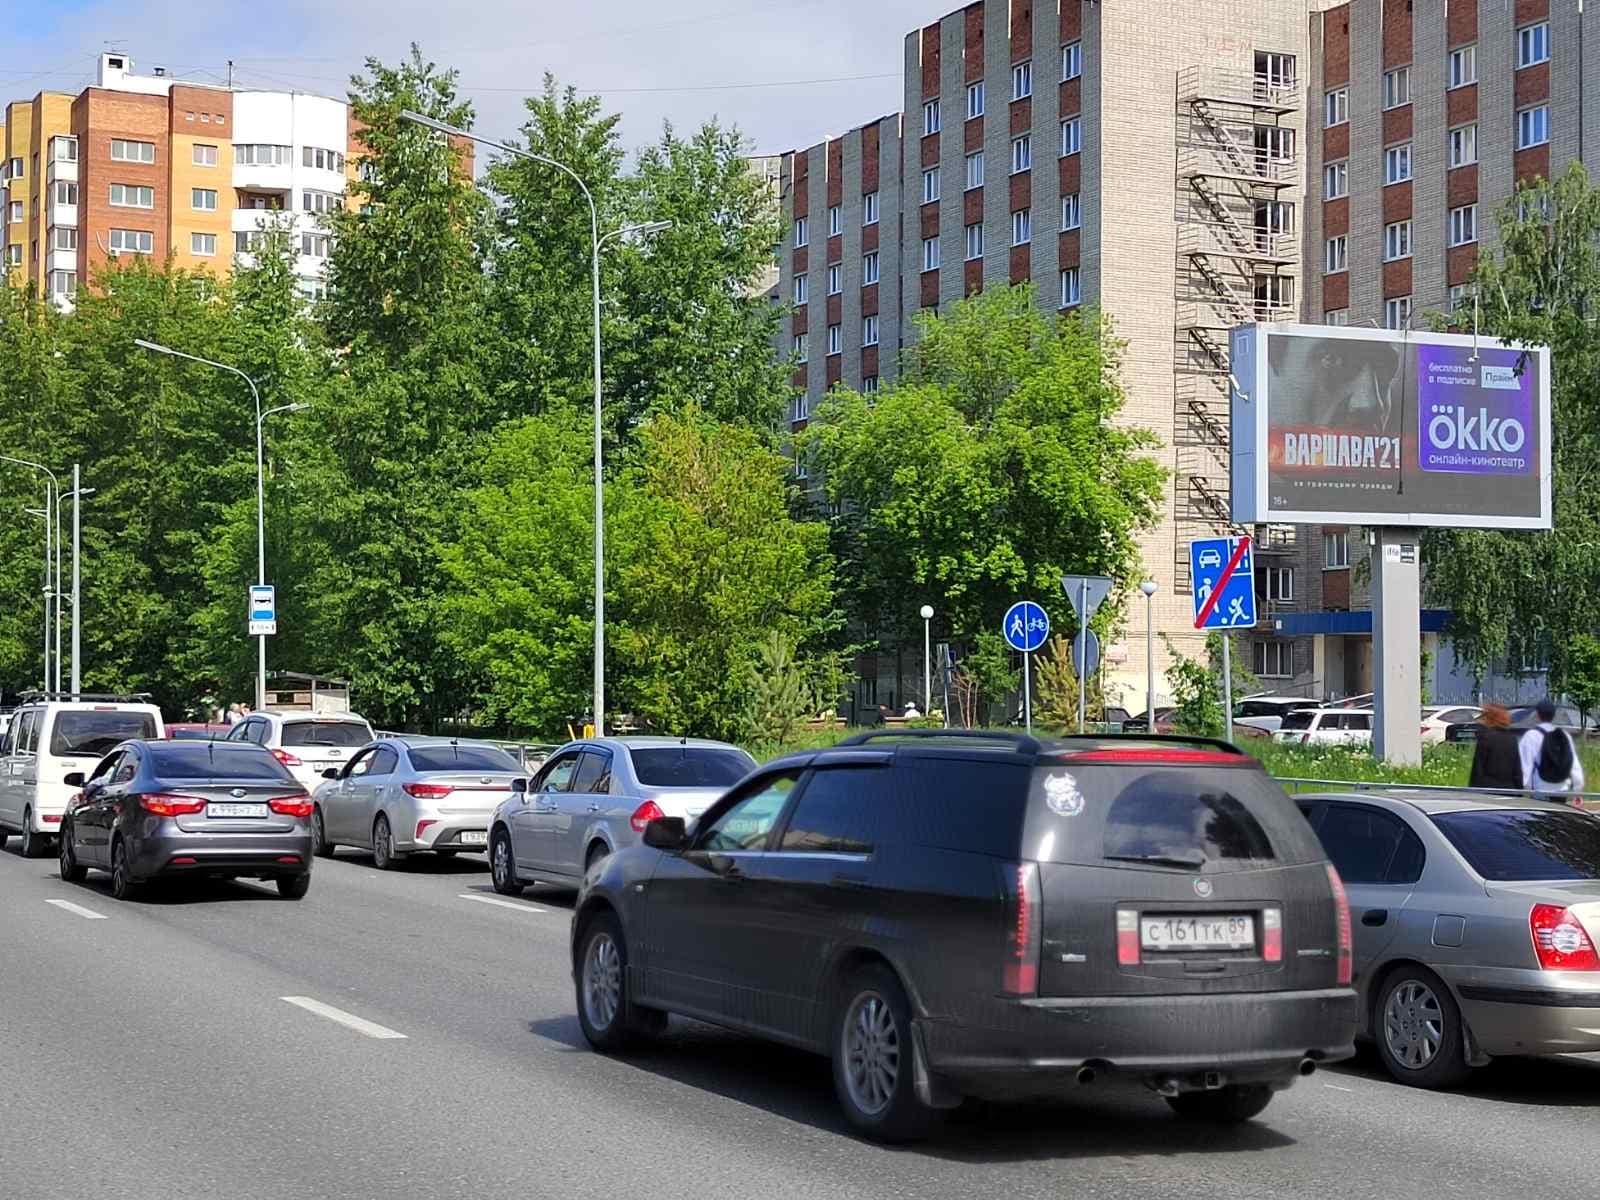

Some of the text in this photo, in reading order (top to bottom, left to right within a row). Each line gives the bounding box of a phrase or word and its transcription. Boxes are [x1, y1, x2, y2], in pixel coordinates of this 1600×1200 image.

[1428, 362, 1473, 374] бесплатно
[1285, 433, 1400, 469] ВАРШАВА'21
[1429, 453, 1525, 469] онлайн-кинотеатр
